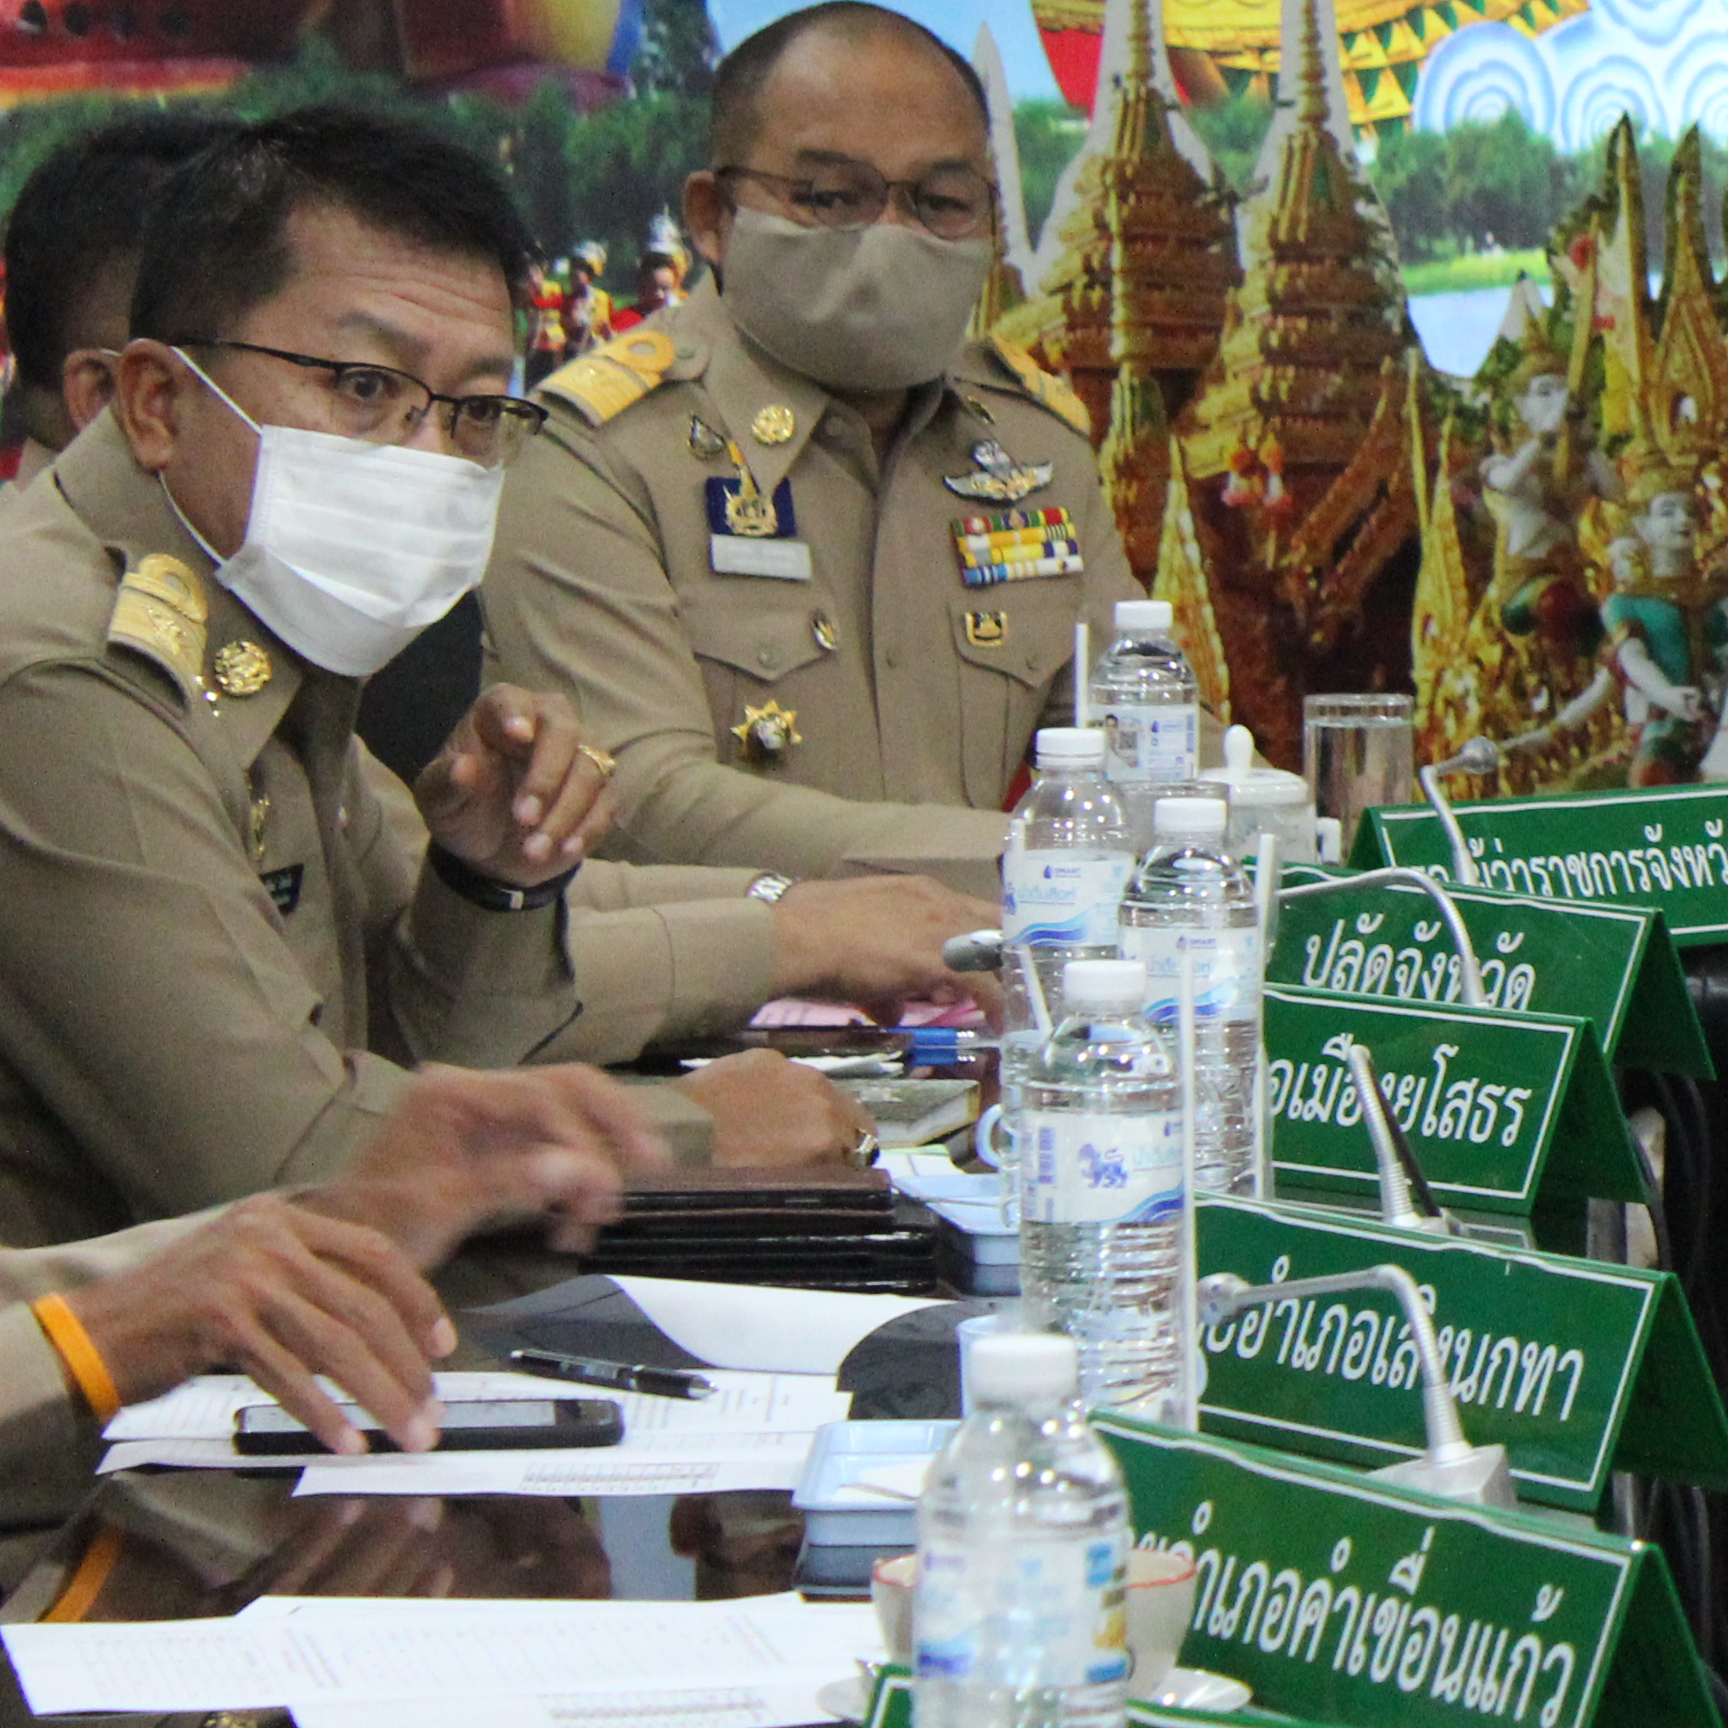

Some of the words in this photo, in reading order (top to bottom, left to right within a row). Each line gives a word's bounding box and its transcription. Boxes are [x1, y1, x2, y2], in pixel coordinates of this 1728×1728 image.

[1303, 913, 1536, 1010] ปลัดจังหวัด
[1269, 1033, 1532, 1146] อเมือยโสธร
[1199, 1255, 1584, 1421] อำเภอเลิงนกทา
[1130, 1500, 1576, 1727] ำเภอคำเขื่อนแก้ว
